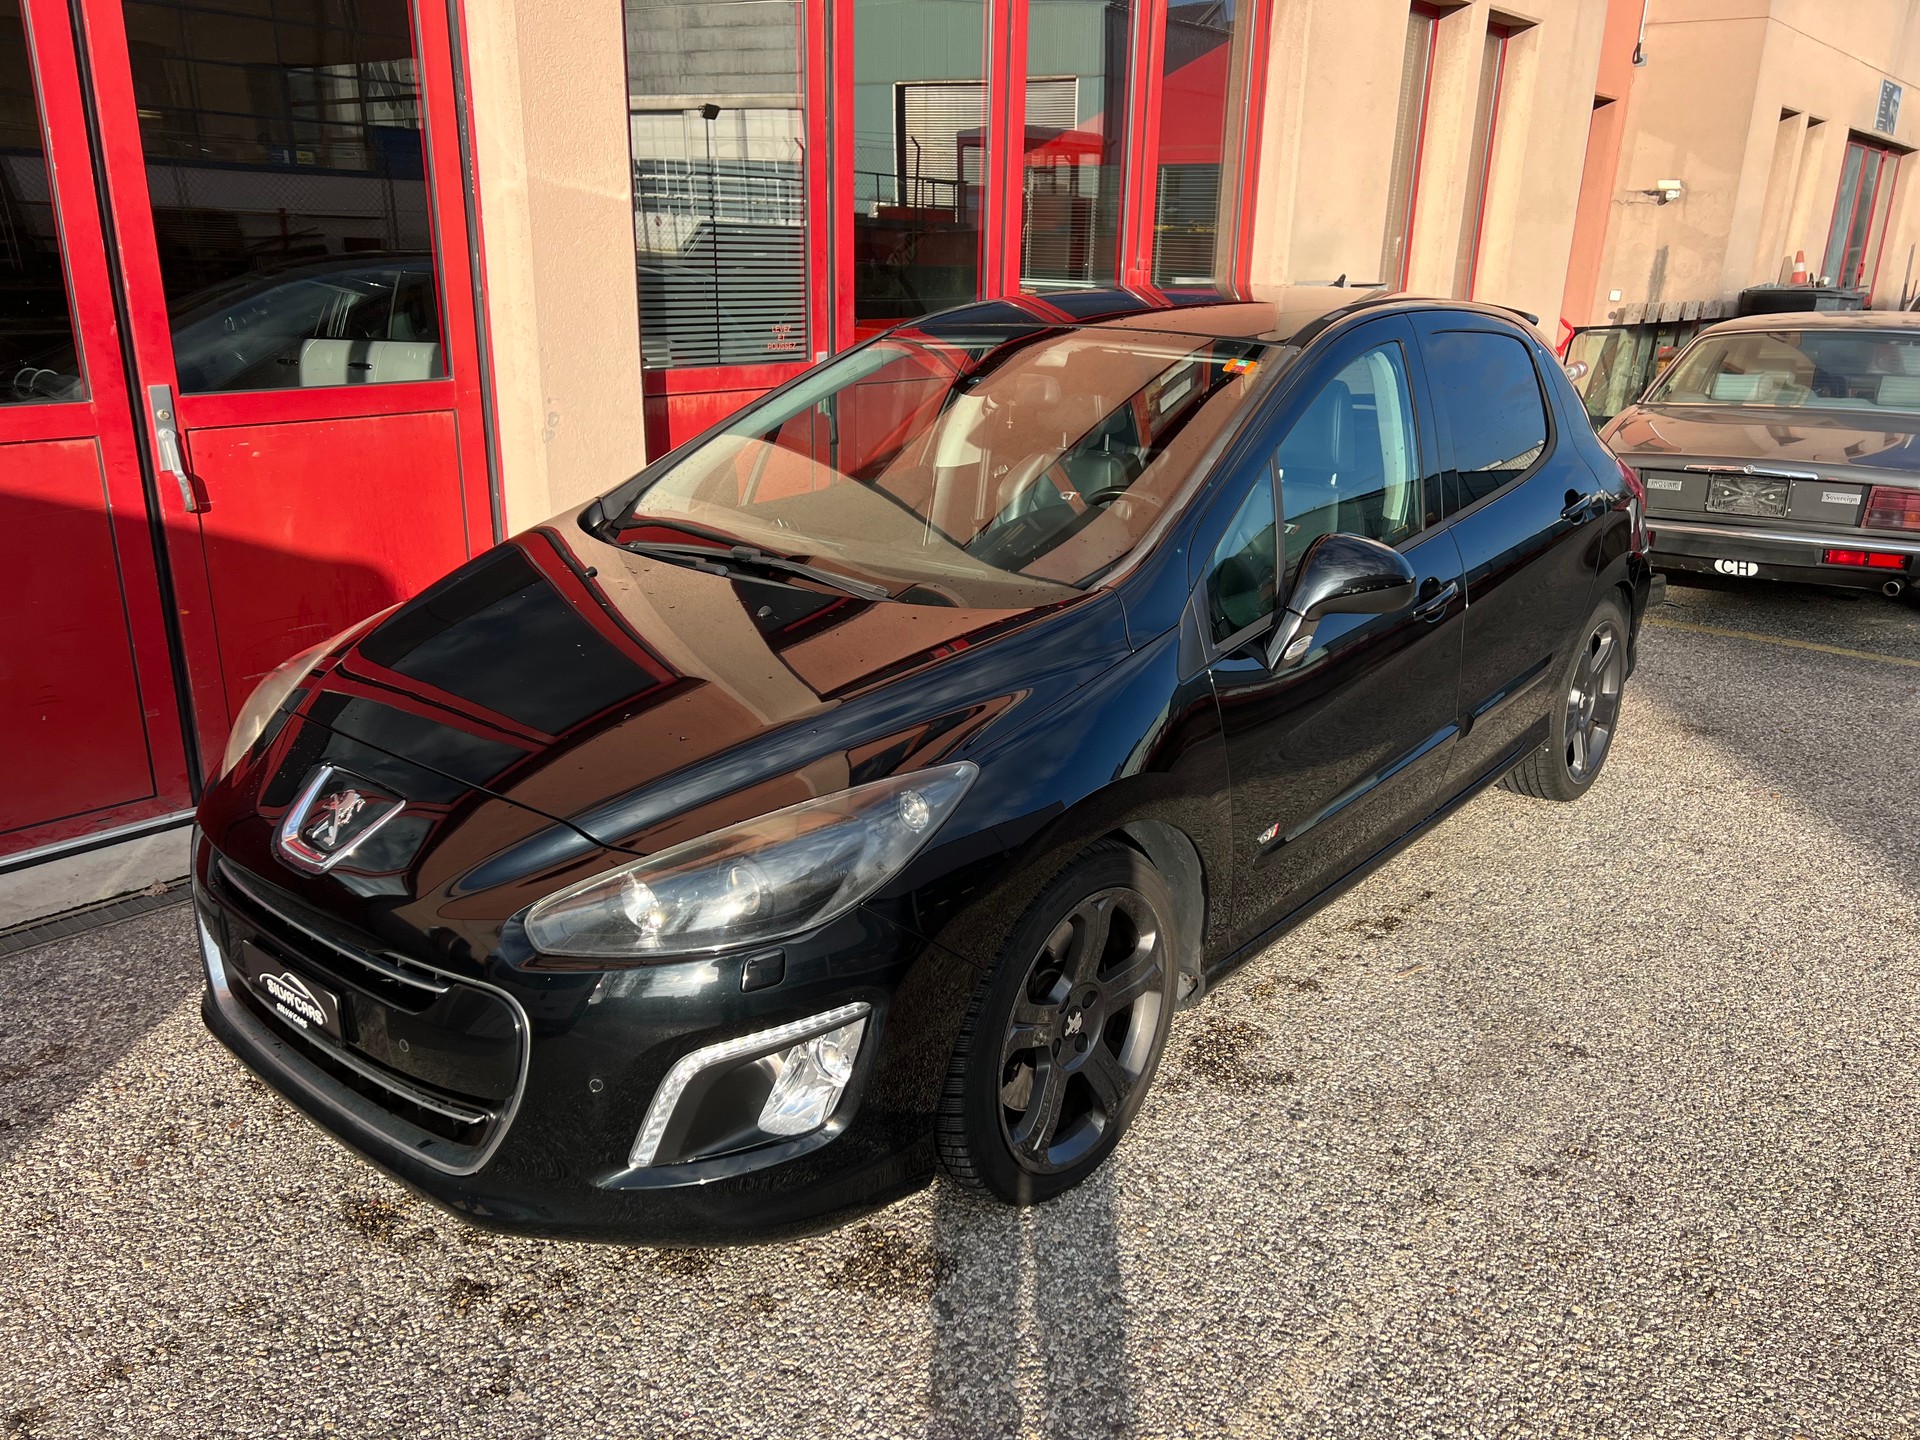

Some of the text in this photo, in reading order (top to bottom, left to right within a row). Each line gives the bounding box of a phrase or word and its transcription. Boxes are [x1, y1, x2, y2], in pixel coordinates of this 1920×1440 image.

[771, 324, 792, 333] LEVEZ
[777, 333, 785, 341] ET
[767, 342, 797, 350] POUSSEZ
[1825, 493, 1858, 504] Sovereign
[1722, 558, 1749, 577] CH
